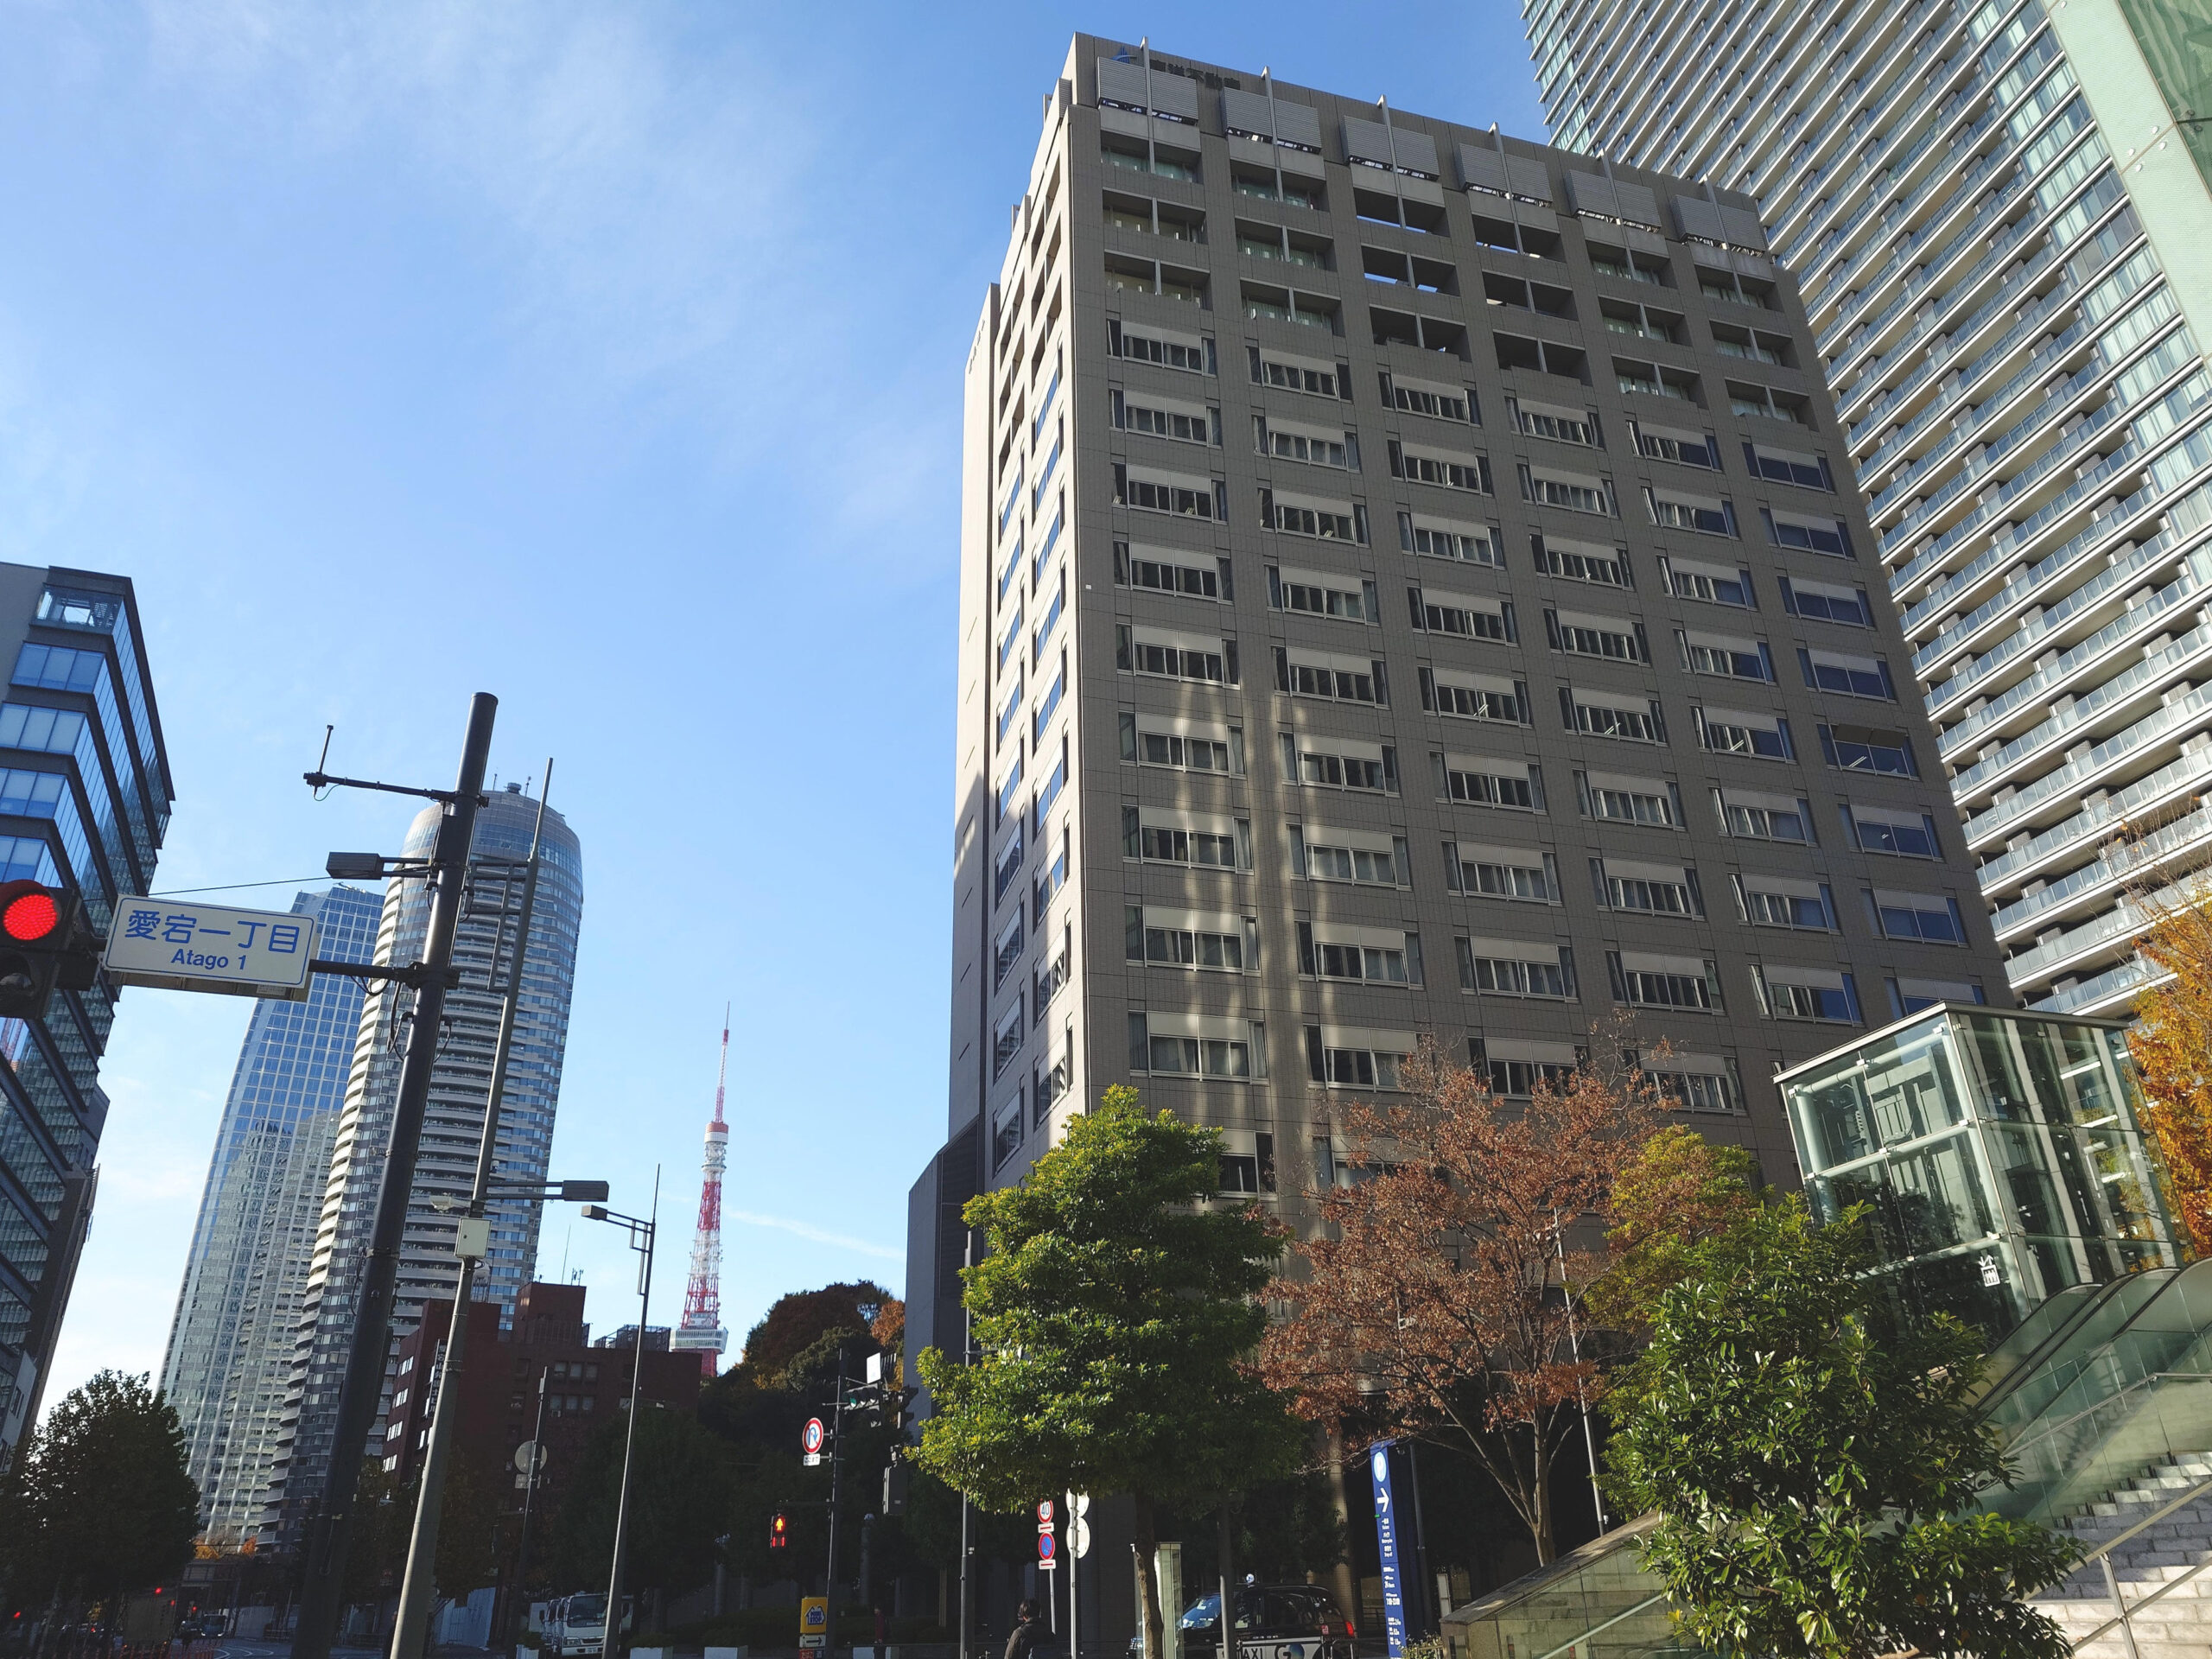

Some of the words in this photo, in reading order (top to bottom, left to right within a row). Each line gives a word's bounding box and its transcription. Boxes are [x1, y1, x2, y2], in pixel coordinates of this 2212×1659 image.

[124, 910, 300, 954] 愛宕一丁目
[170, 949, 229, 969] Atago
[238, 955, 247, 970] 1
[1041, 1503, 1050, 1516] 40
